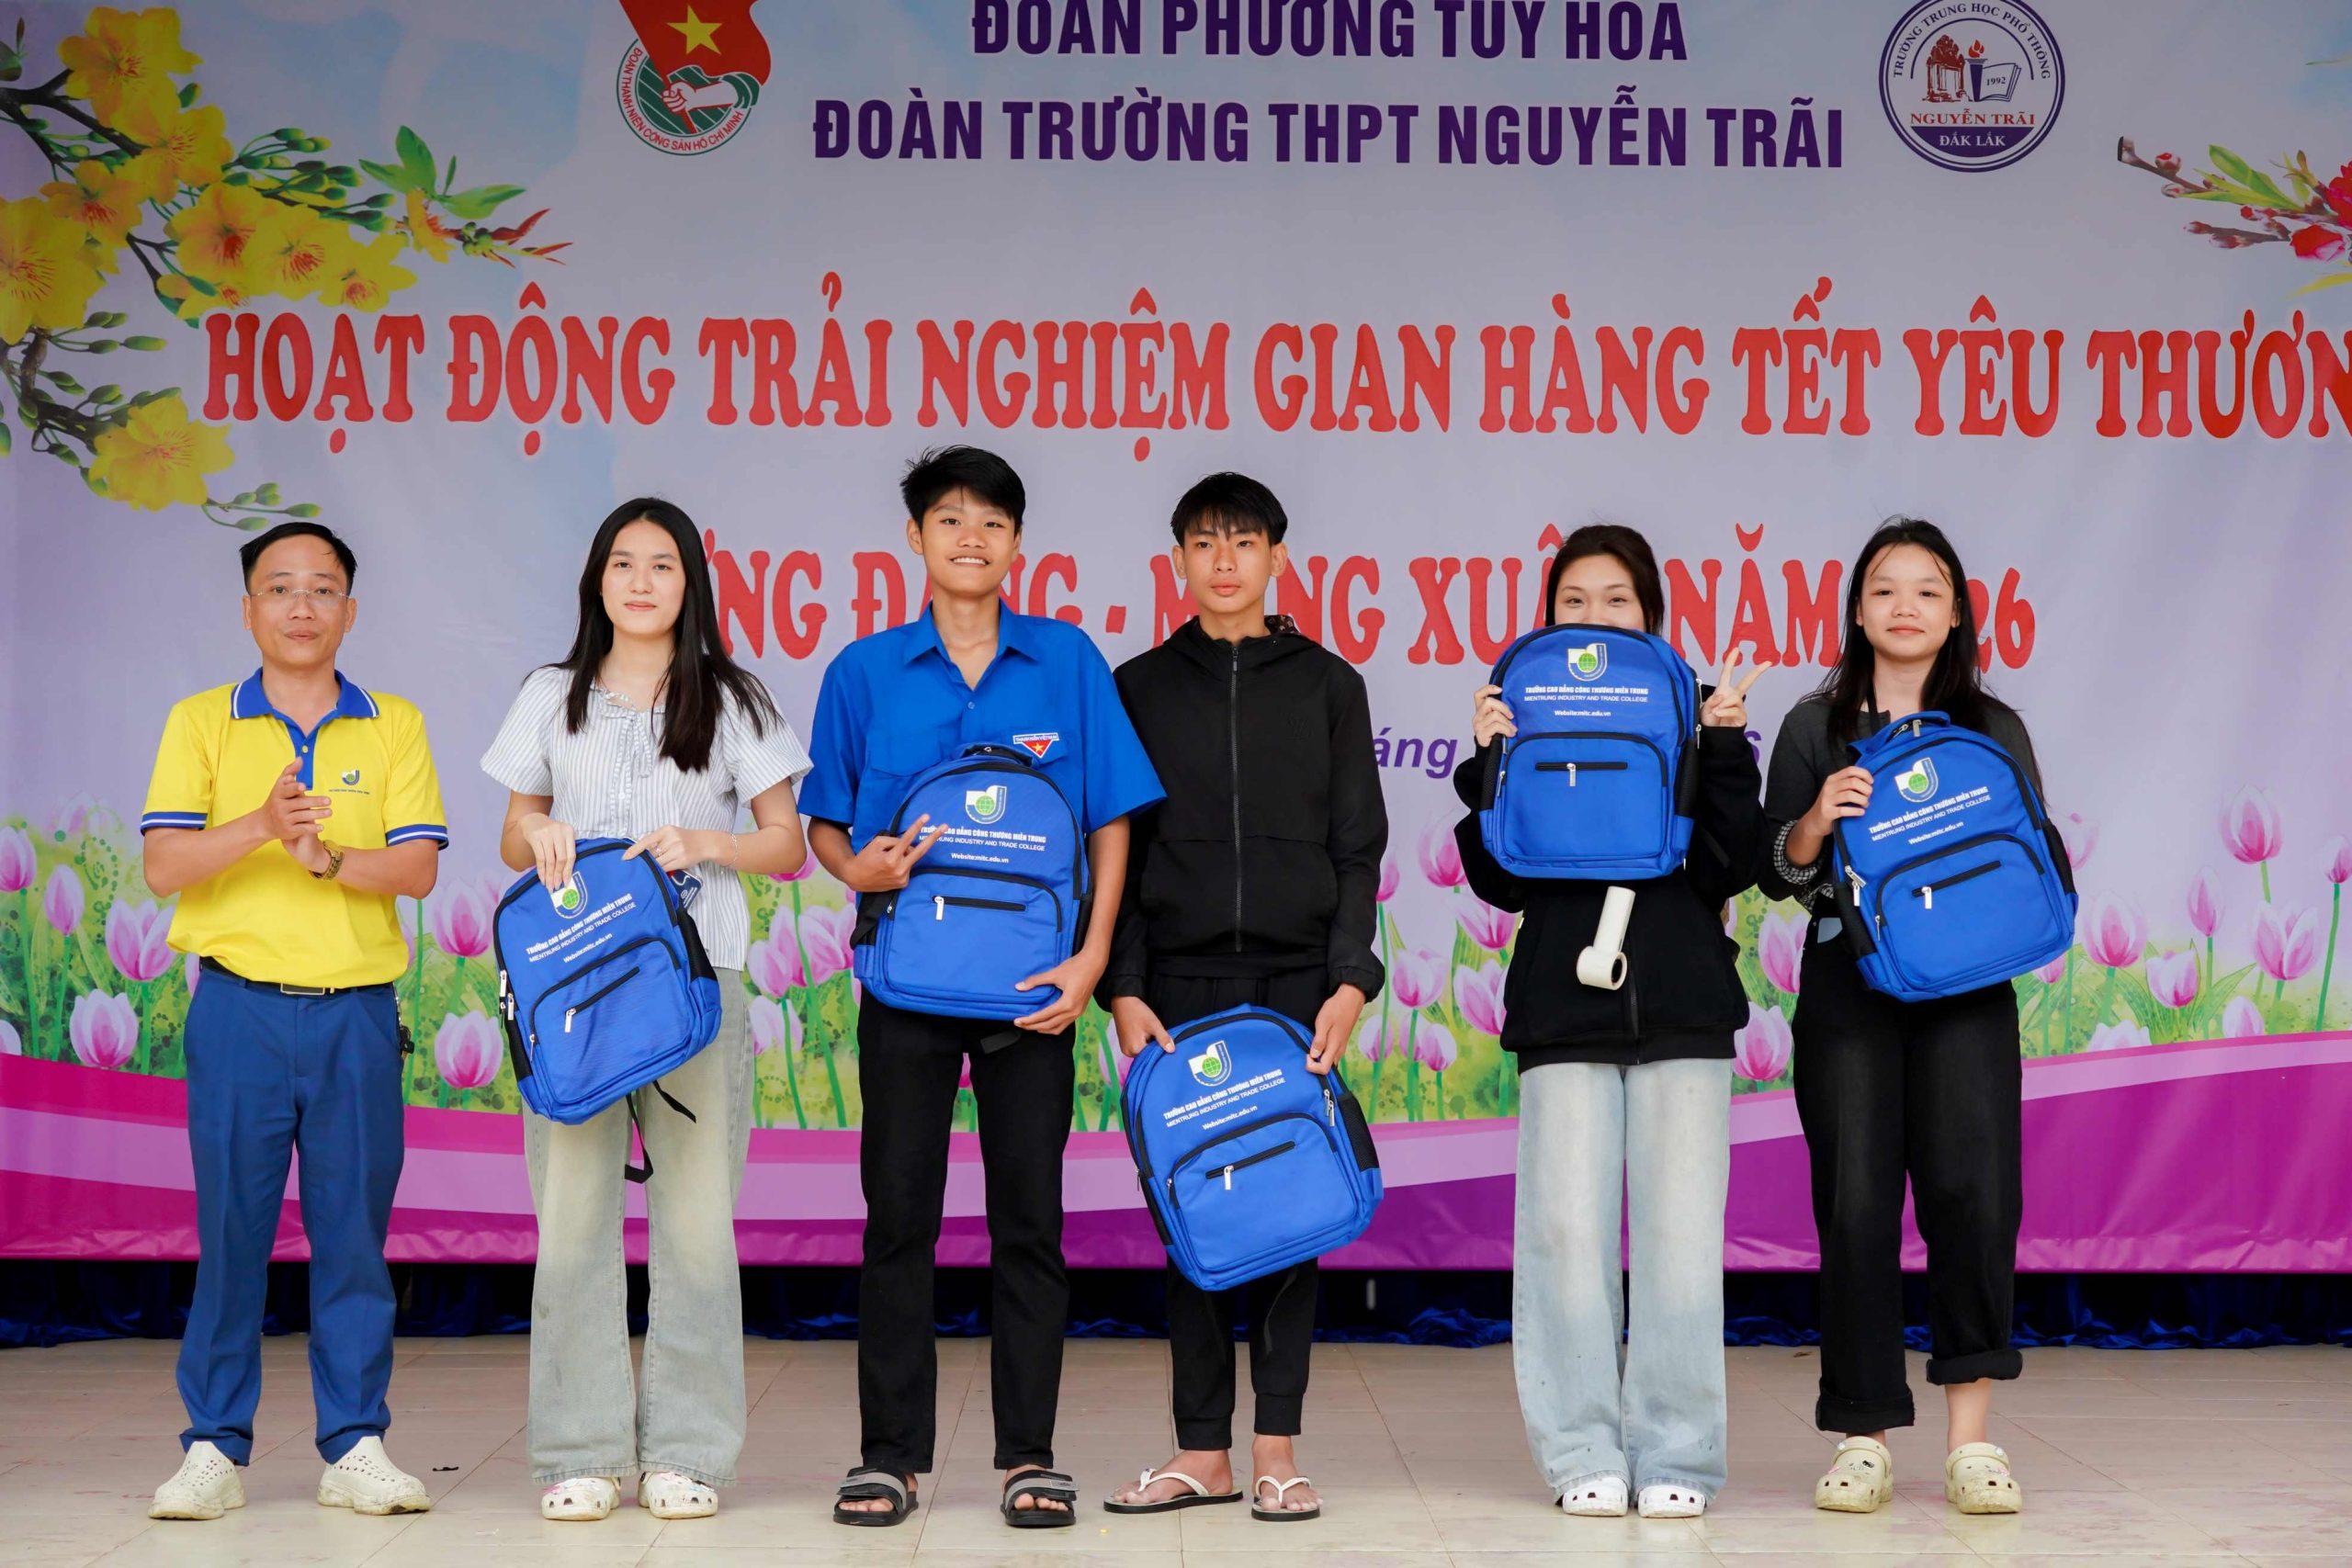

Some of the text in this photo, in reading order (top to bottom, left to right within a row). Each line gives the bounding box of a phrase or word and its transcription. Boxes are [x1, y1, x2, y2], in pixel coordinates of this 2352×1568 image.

[1434, 0, 1545, 58] TUY
[1921, 3, 1966, 27] TRUNG
[1972, 3, 1999, 17] HỌC
[2027, 33, 2051, 79] THÔNG
[1986, 76, 2006, 86] 1992
[621, 75, 634, 108] THANH
[722, 111, 743, 133] MINH
[1911, 108, 2035, 125] NGUYỄN TRÃI
[813, 85, 1842, 168] ĐOÀN TRƯỜNG THPT NGUYỄN TRÃI
[1939, 131, 2006, 146] ĐẮK LẮK
[203, 271, 2352, 462] HOẠT ĐỘNG TRẢI NGHIỆM GIAN HÀNG TẾT YÊU THƯƠN
[704, 528, 827, 660] NG
[1149, 554, 1385, 665] MNG
[1664, 523, 1843, 668] NĂM
[1374, 727, 1458, 779] áng
[1905, 816, 1933, 829] INDUSTRY
[1933, 811, 1946, 819] AND
[1946, 804, 1964, 814] TRADE
[1965, 795, 1991, 807] COLLEGE
[1019, 843, 1045, 852] COLLEGE
[583, 925, 594, 934] AND
[1200, 1100, 1227, 1114] INDUSTRY
[1227, 1096, 1239, 1104] AND
[1239, 1088, 1259, 1099] TRADE
[1260, 1077, 1285, 1091] COLLEGE
